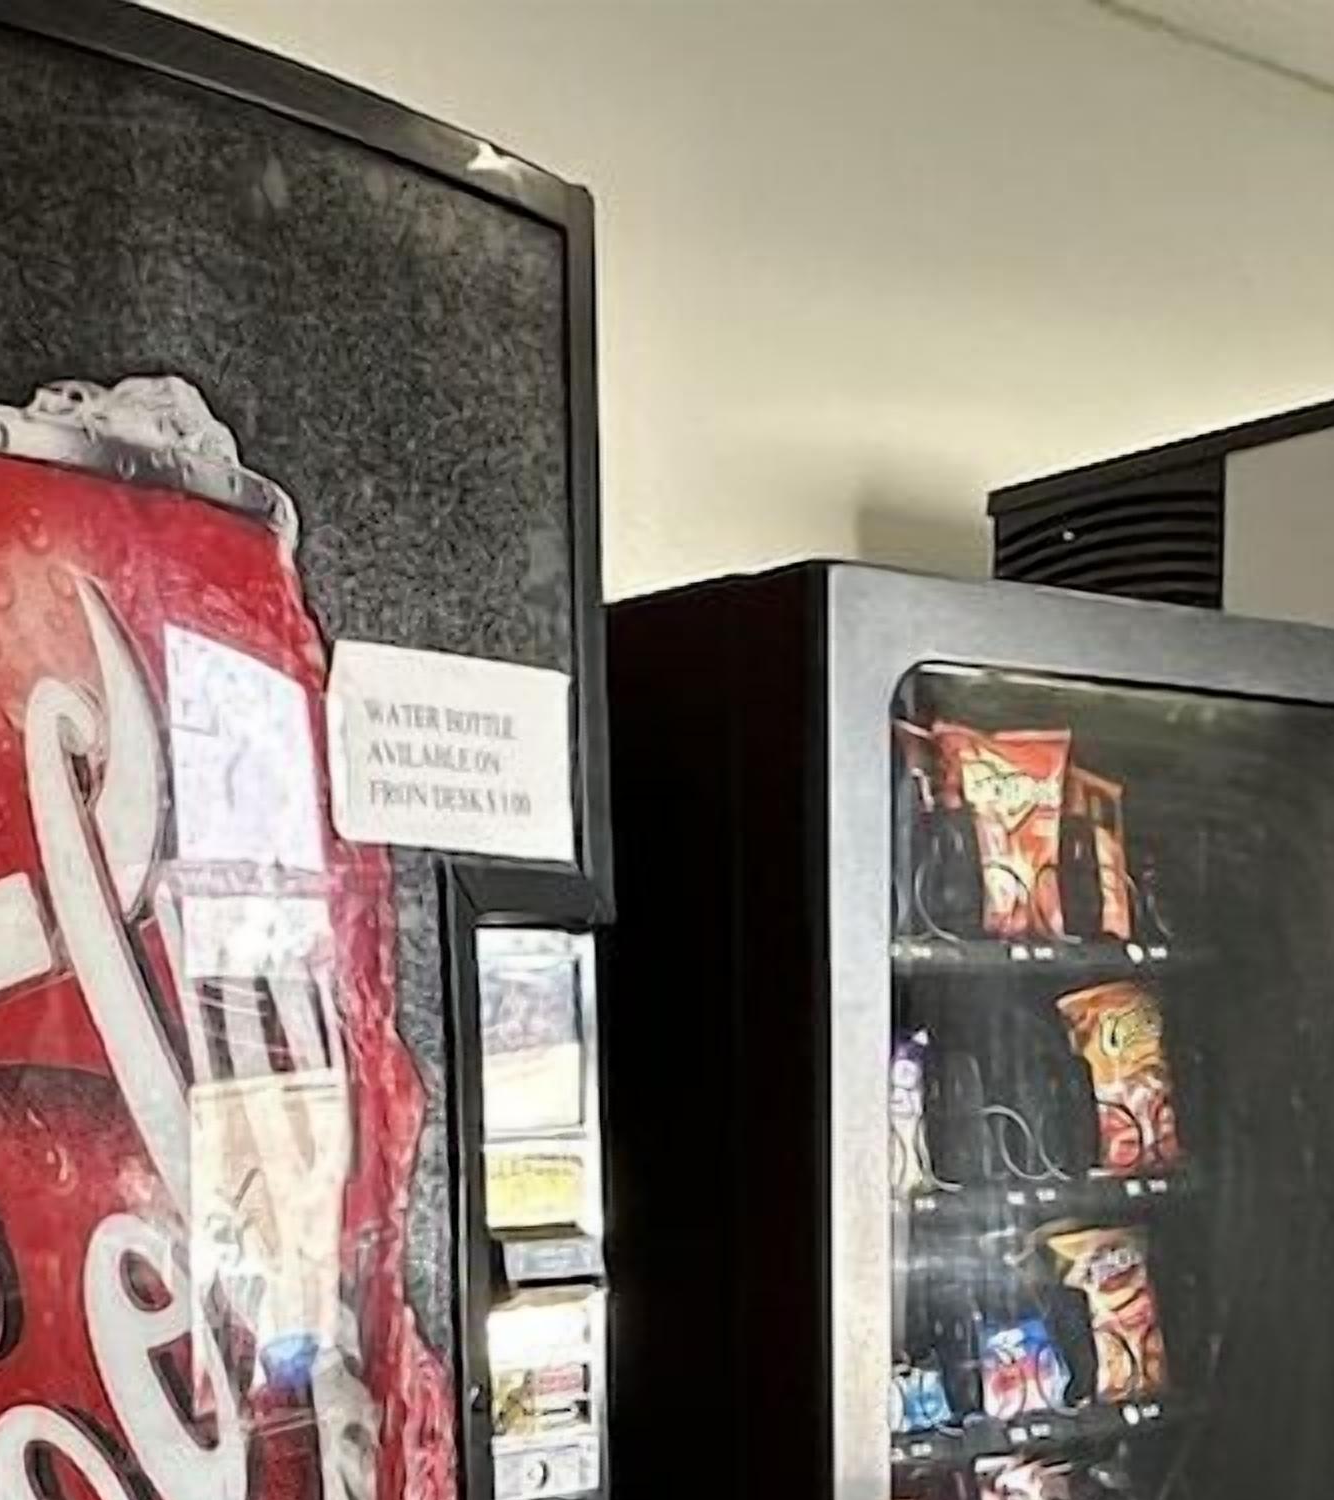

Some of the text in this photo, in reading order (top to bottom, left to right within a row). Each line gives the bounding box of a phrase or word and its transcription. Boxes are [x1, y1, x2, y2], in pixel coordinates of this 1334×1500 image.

[363, 699, 518, 740] WATER BOTTLE
[432, 784, 484, 813] DESK
